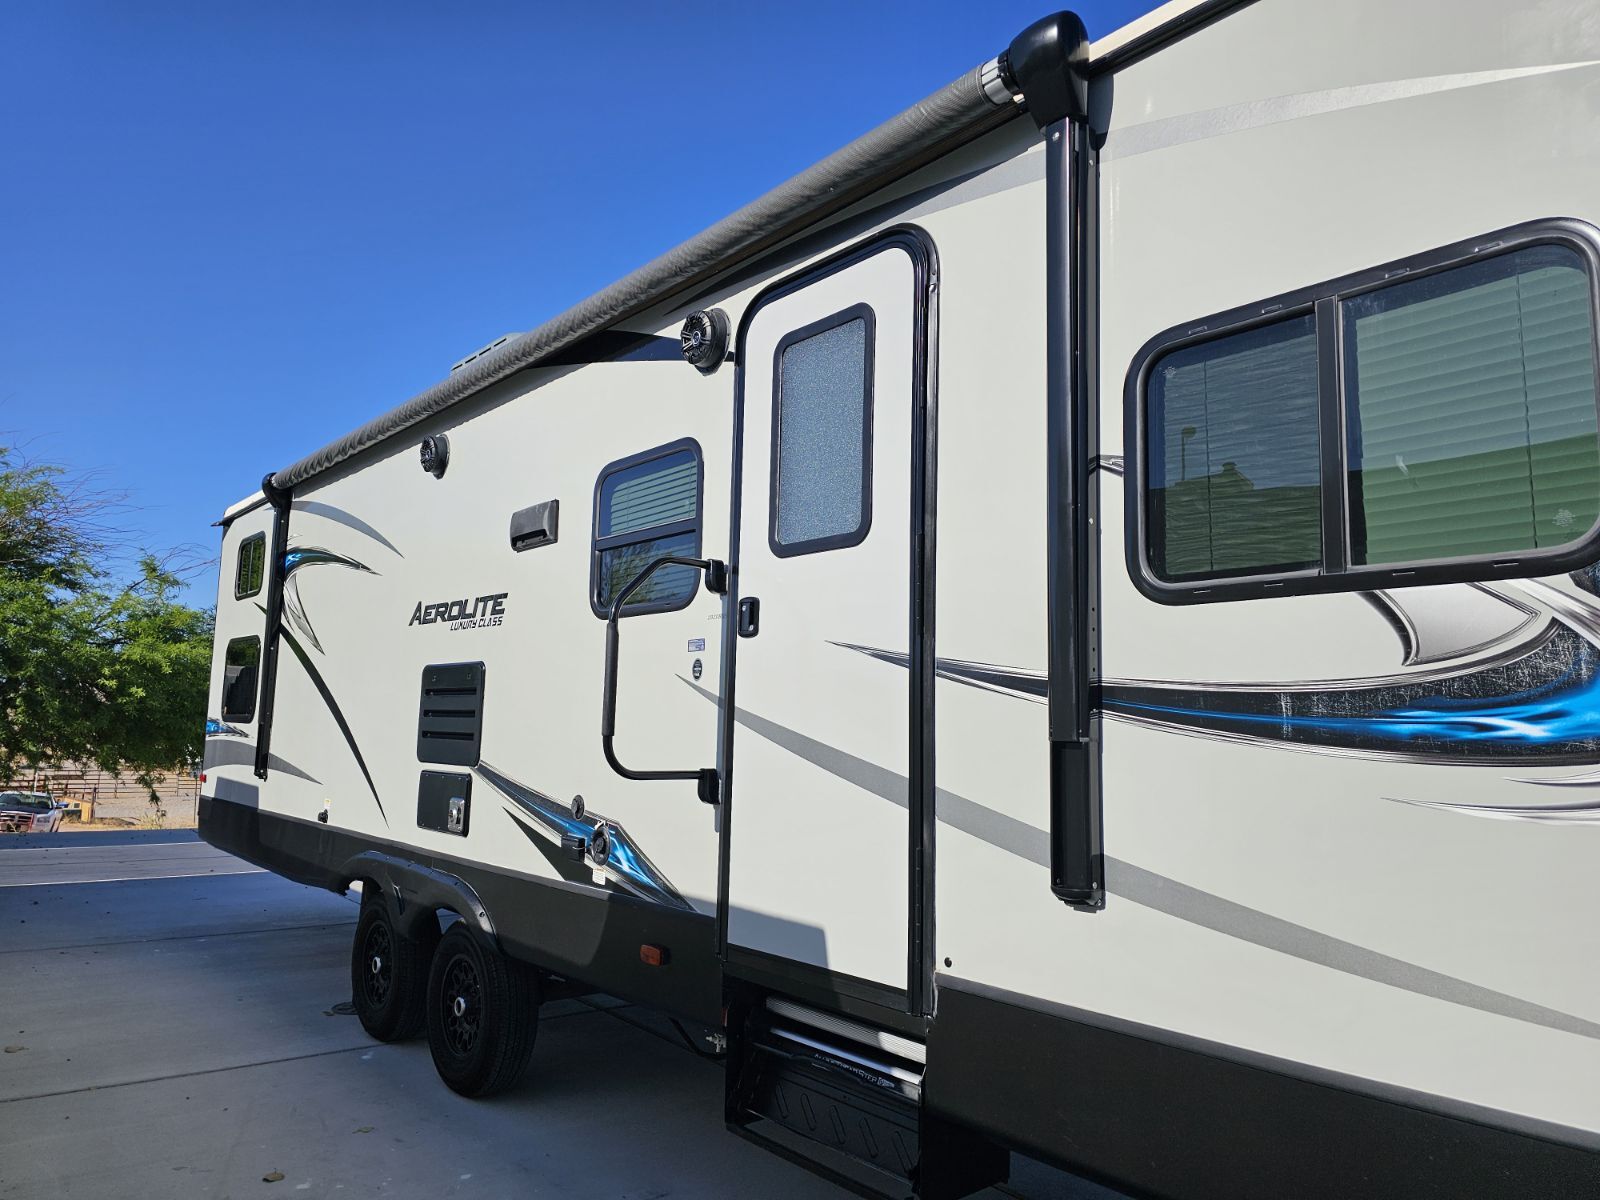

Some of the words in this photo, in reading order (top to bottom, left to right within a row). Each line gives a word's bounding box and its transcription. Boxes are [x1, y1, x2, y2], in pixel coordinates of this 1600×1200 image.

[408, 592, 508, 627] AEROLITE
[450, 619, 477, 631] LUXURY
[478, 616, 503, 628] CLASS
